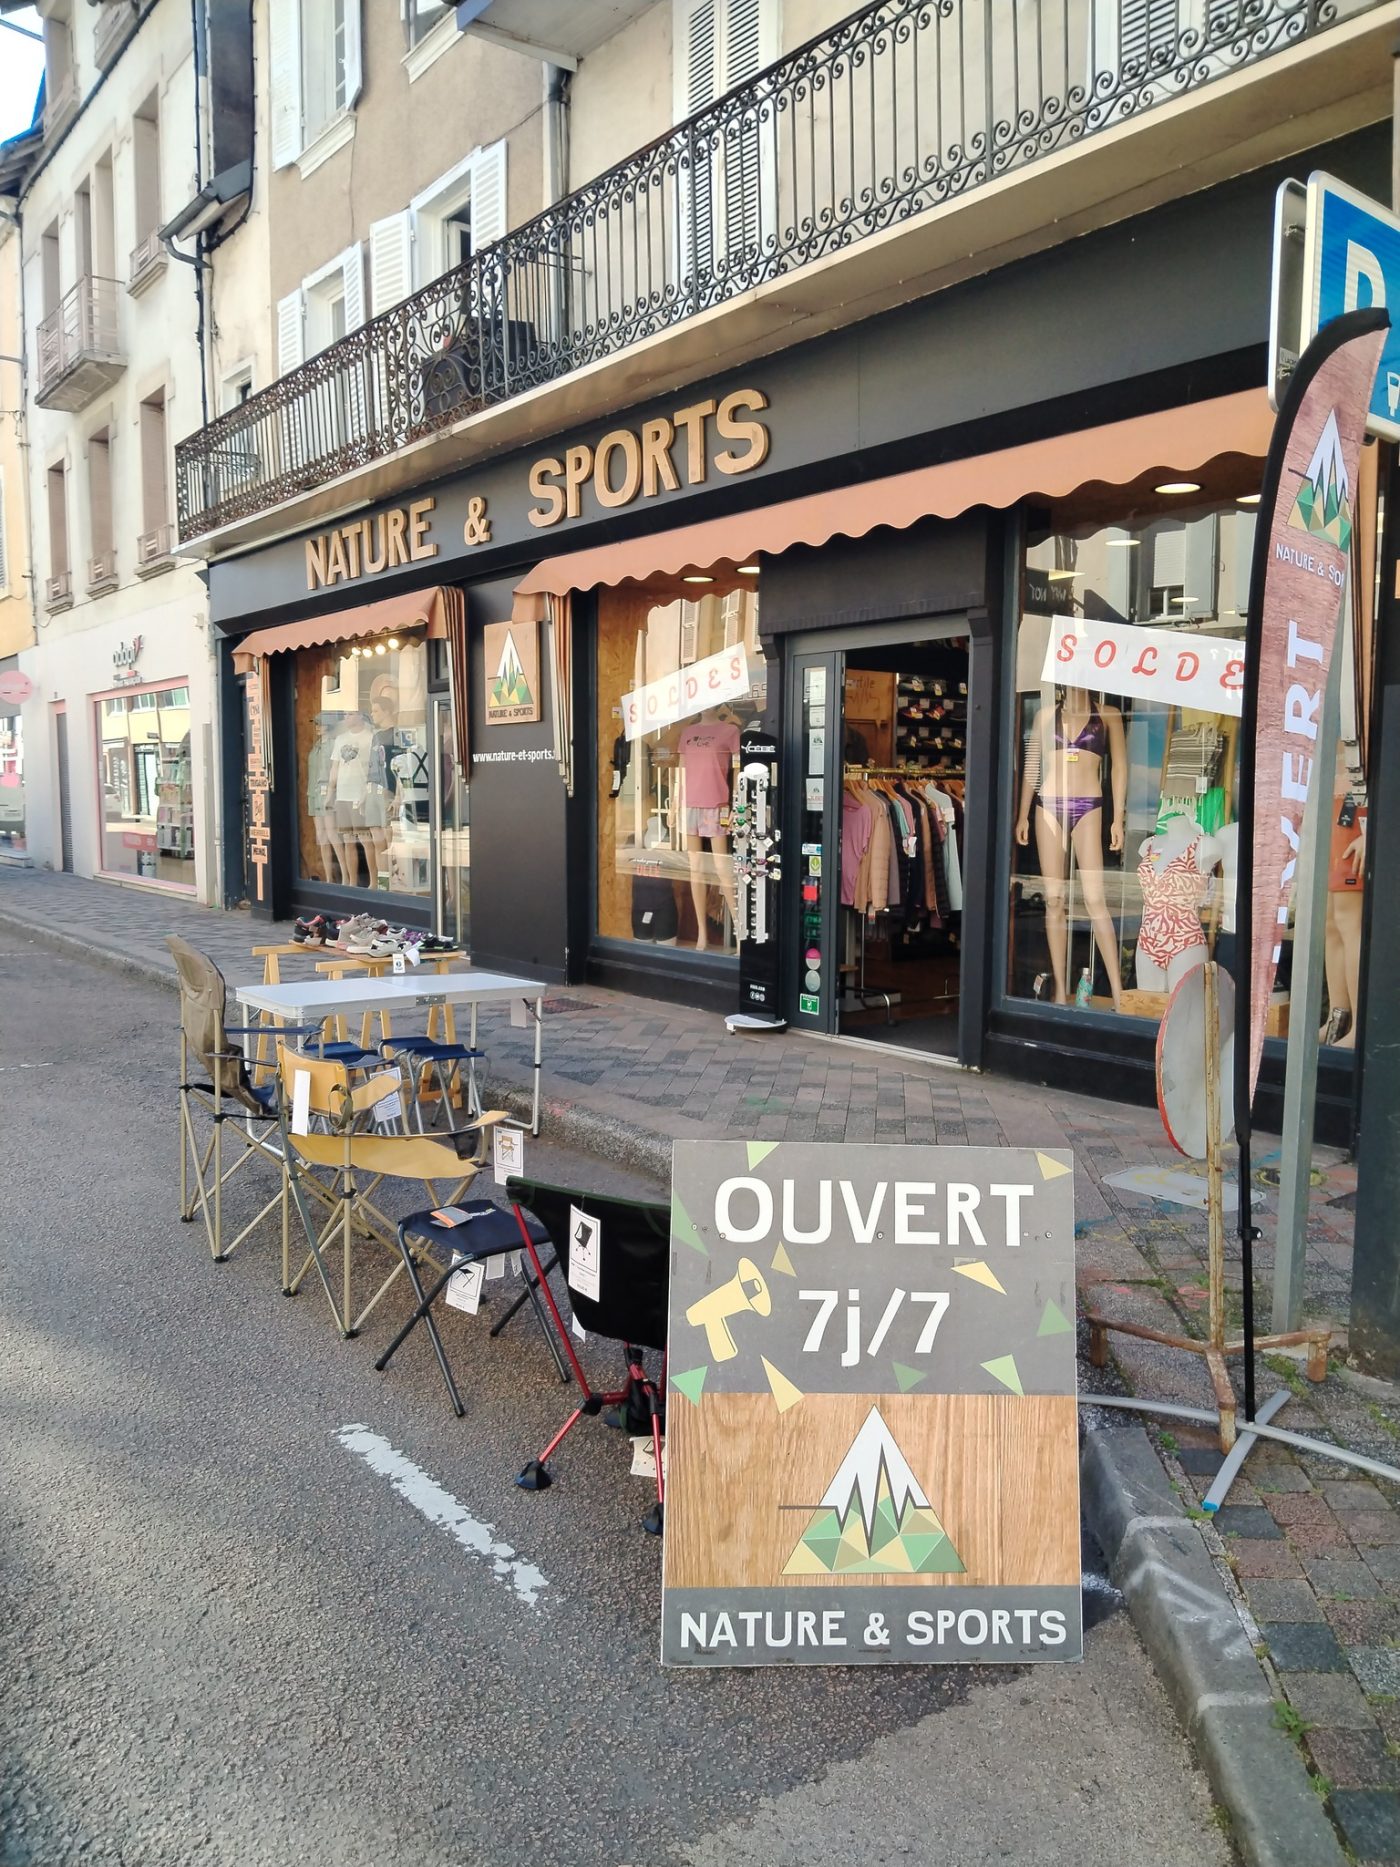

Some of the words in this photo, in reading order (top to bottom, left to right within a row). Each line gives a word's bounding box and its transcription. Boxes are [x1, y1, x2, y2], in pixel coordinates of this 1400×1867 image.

[305, 497, 438, 590] NATURE
[464, 496, 491, 546] &
[527, 388, 769, 528] SPORTS
[1275, 543, 1315, 573] NATURE
[1317, 561, 1325, 577] &
[488, 709, 508, 719] NATURE
[513, 707, 534, 717] SPORTS
[628, 656, 742, 724] SOLDES
[714, 1176, 1034, 1247] OUVERT
[799, 1288, 950, 1368] 7j/7
[680, 1611, 847, 1648] NATURE
[863, 1612, 890, 1647] &
[906, 1609, 1067, 1646] SPORTS
